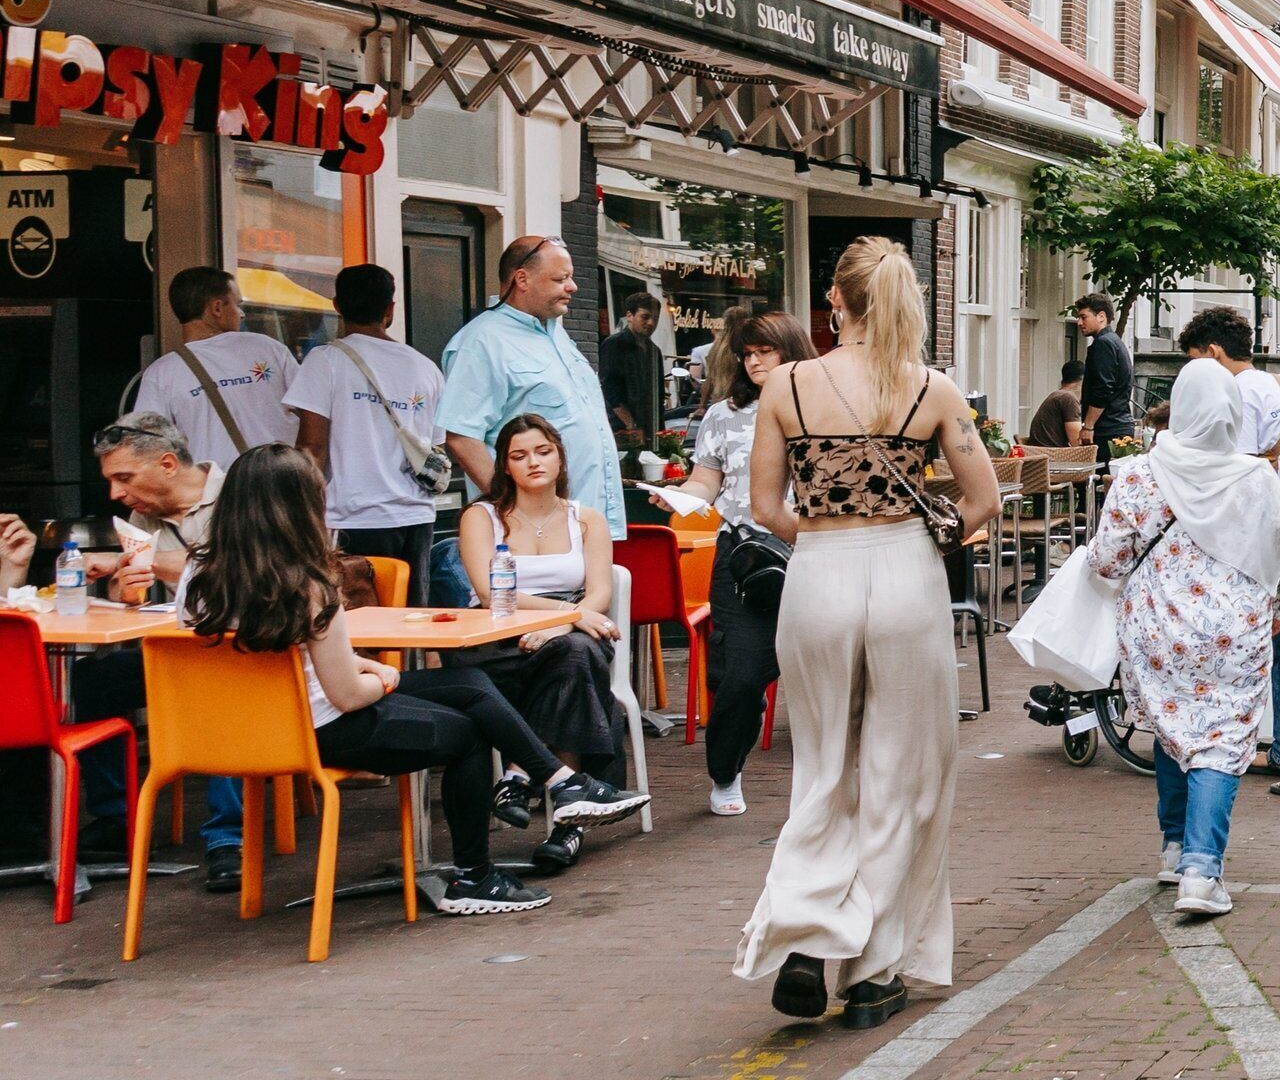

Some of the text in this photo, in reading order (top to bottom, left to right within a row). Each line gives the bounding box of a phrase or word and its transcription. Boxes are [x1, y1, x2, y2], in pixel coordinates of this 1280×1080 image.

[757, 0, 815, 45] snacks
[833, 20, 869, 62] take
[872, 41, 910, 82] away
[0, 25, 388, 176] ipsy King
[8, 189, 54, 209] ATM
[242, 228, 295, 253] OPEN
[629, 246, 677, 271] TAPAS
